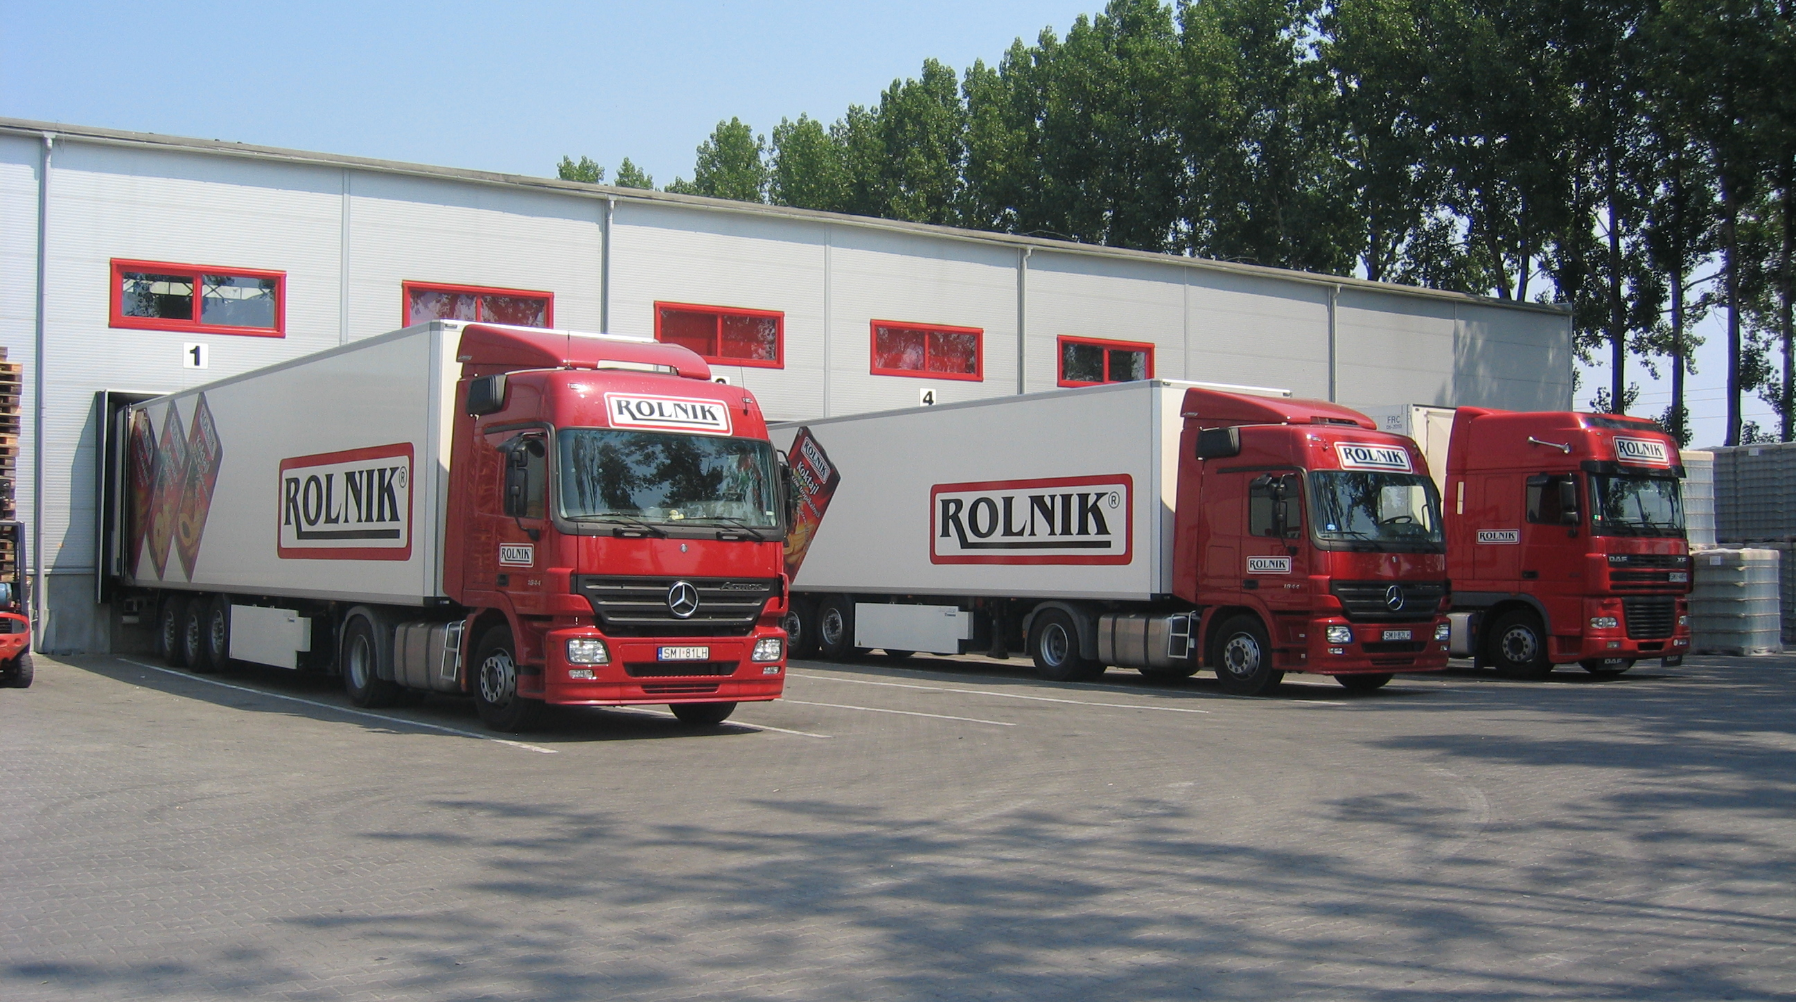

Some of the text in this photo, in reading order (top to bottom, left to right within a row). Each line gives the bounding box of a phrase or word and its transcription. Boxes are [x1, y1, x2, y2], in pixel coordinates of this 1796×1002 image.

[189, 345, 200, 366] 1
[922, 390, 935, 406] 4
[614, 399, 720, 426] ROLNIK
[1343, 447, 1406, 467] ROLNIK
[1617, 440, 1664, 460] ROLNIK
[796, 461, 820, 495] Koktajl
[1479, 531, 1516, 541] ROLNIK
[501, 547, 530, 562] ROLNIK
[1249, 559, 1287, 571] ROLNIK
